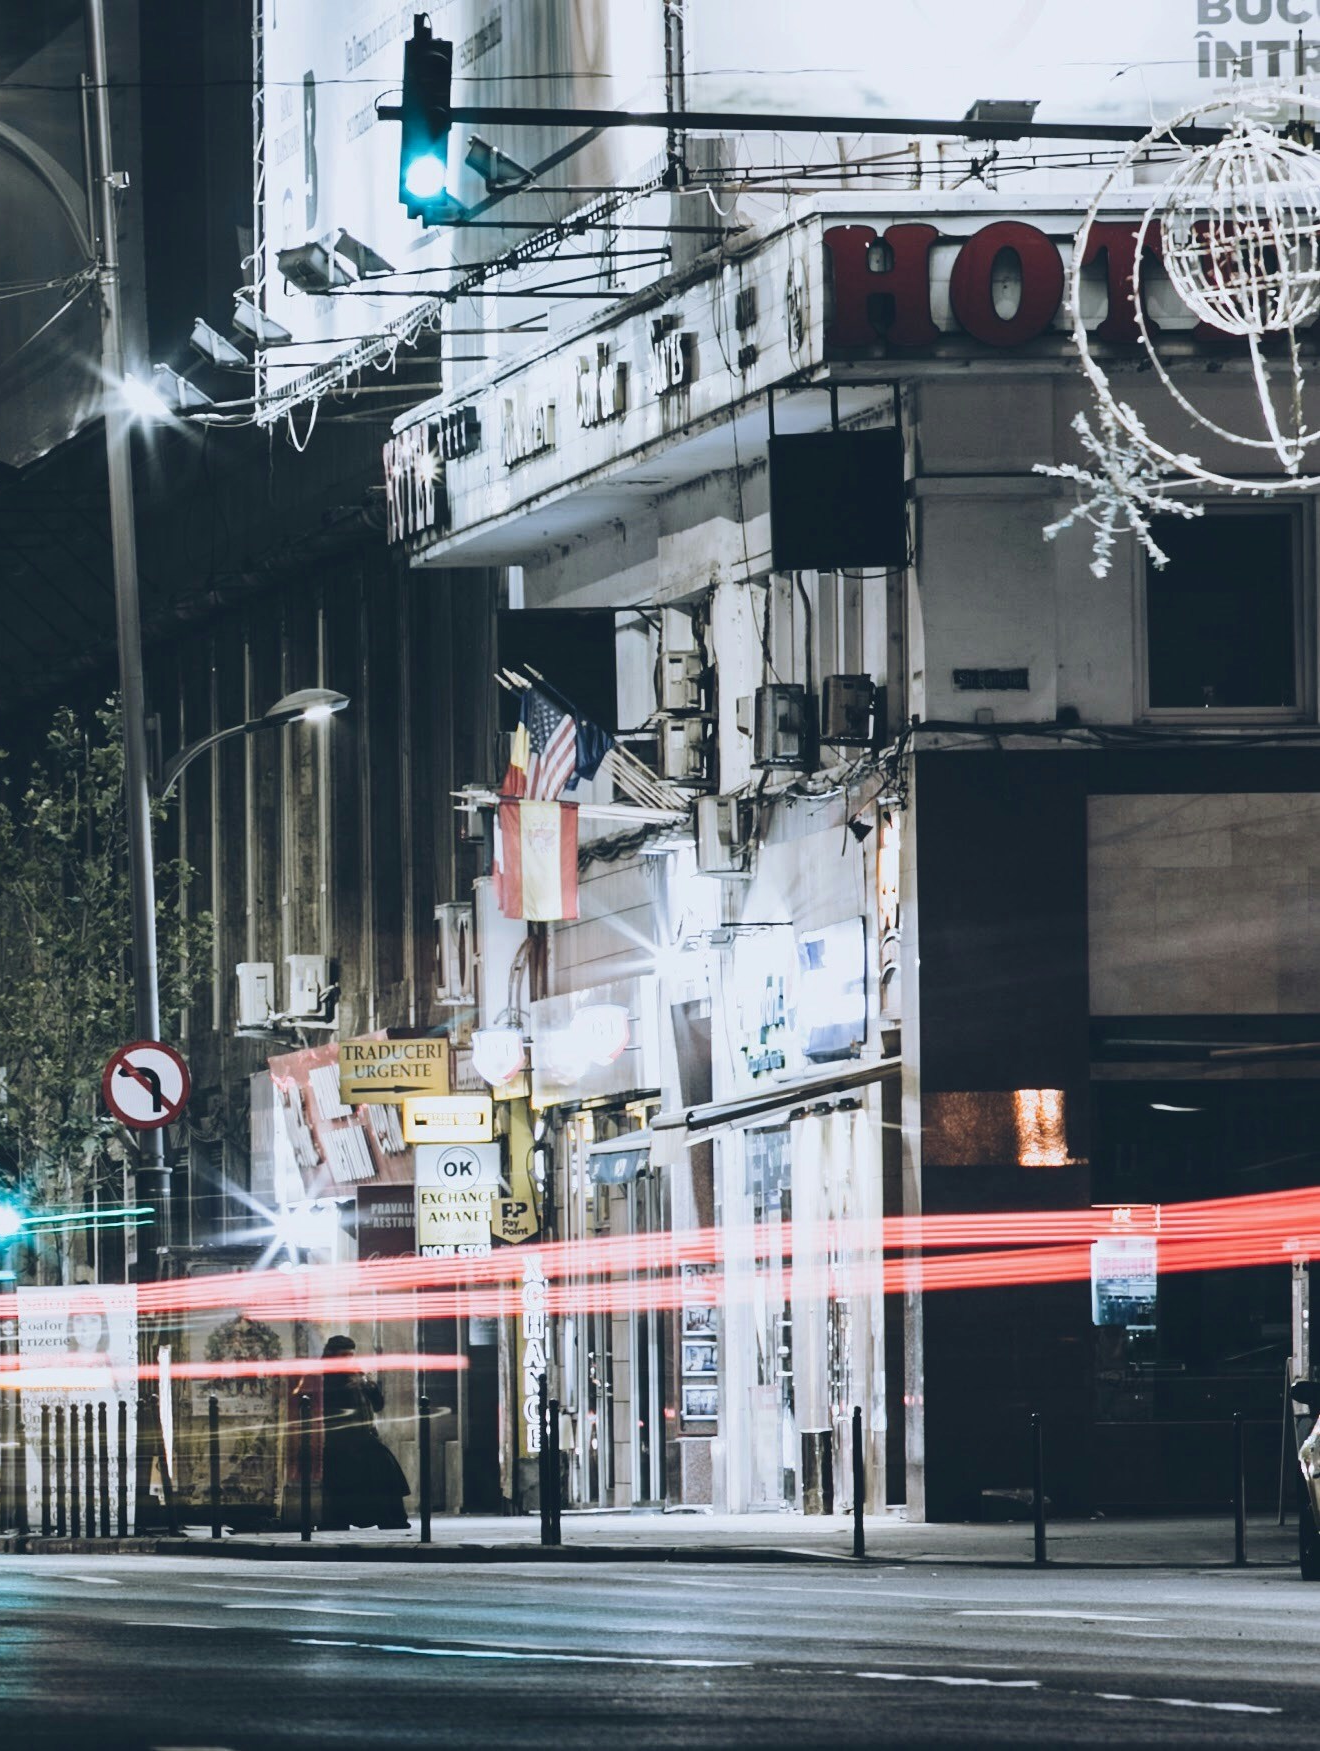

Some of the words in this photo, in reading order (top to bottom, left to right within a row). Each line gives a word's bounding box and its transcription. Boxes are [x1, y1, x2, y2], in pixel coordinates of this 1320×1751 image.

[1197, 0, 1320, 24] BUC
[342, 1043, 443, 1061] TRADUCERI
[354, 1063, 433, 1078] URGENTE
[444, 1161, 473, 1178] OK
[422, 1191, 497, 1205] EXCHANGE
[428, 1210, 491, 1224] AMANET
[502, 1219, 520, 1229] Pay
[503, 1227, 529, 1236] Point
[422, 1245, 455, 1258] NON
[19, 1319, 63, 1331] Coafor
